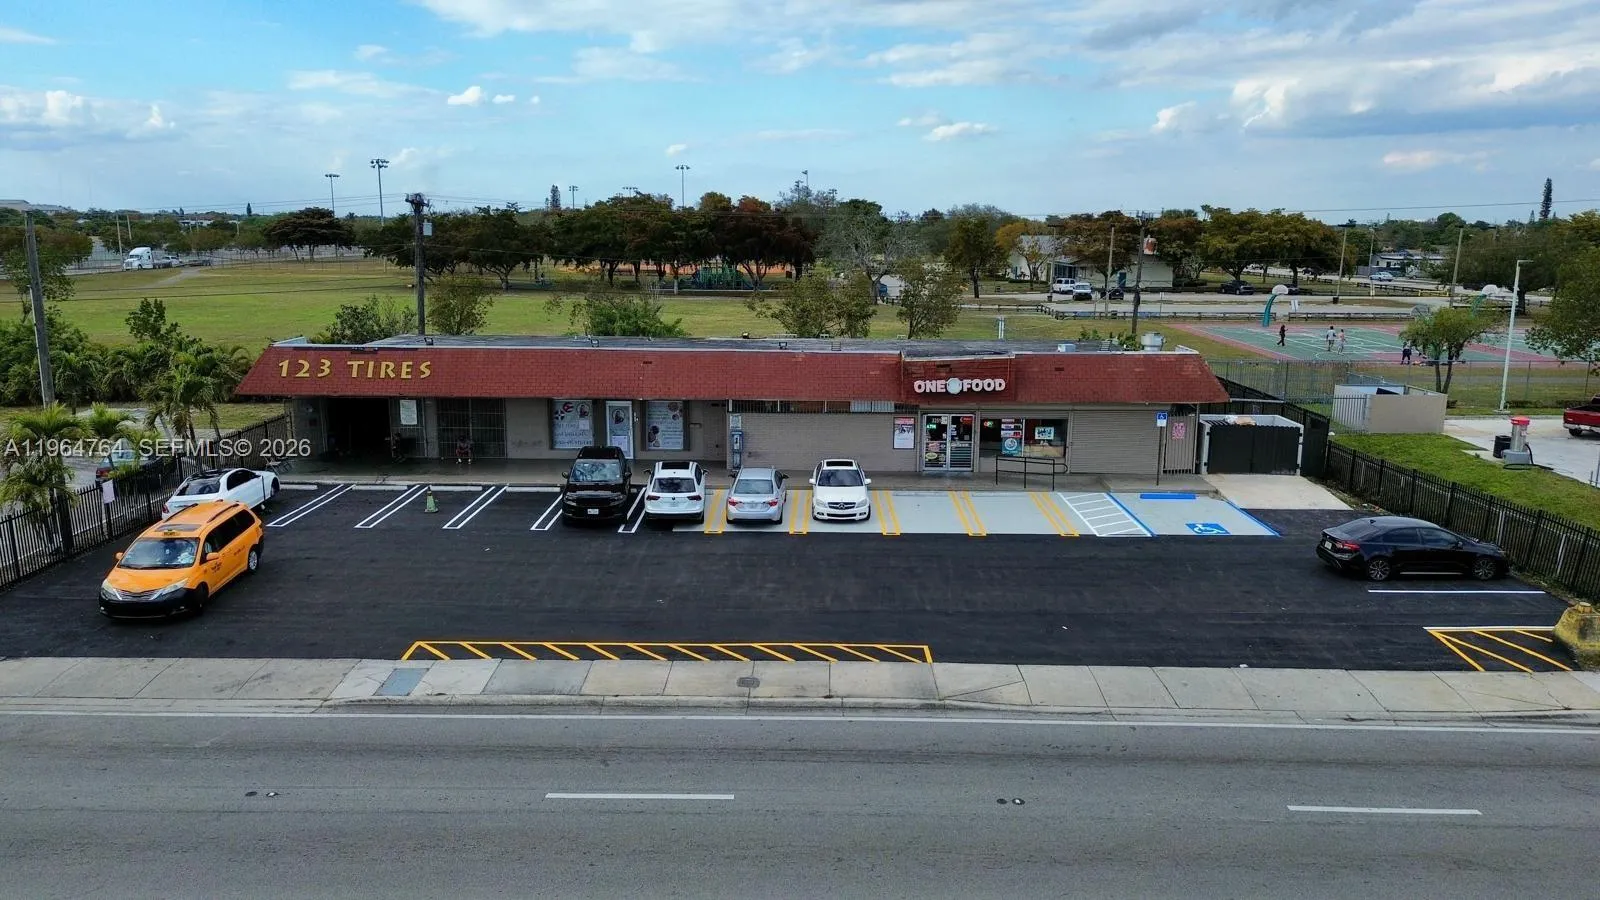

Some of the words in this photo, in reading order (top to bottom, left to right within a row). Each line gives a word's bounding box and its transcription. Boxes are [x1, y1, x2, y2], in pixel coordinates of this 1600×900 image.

[278, 358, 332, 378] 123
[347, 360, 432, 379] TIRES
[913, 380, 946, 393] ONE
[962, 378, 1006, 392] FOOD
